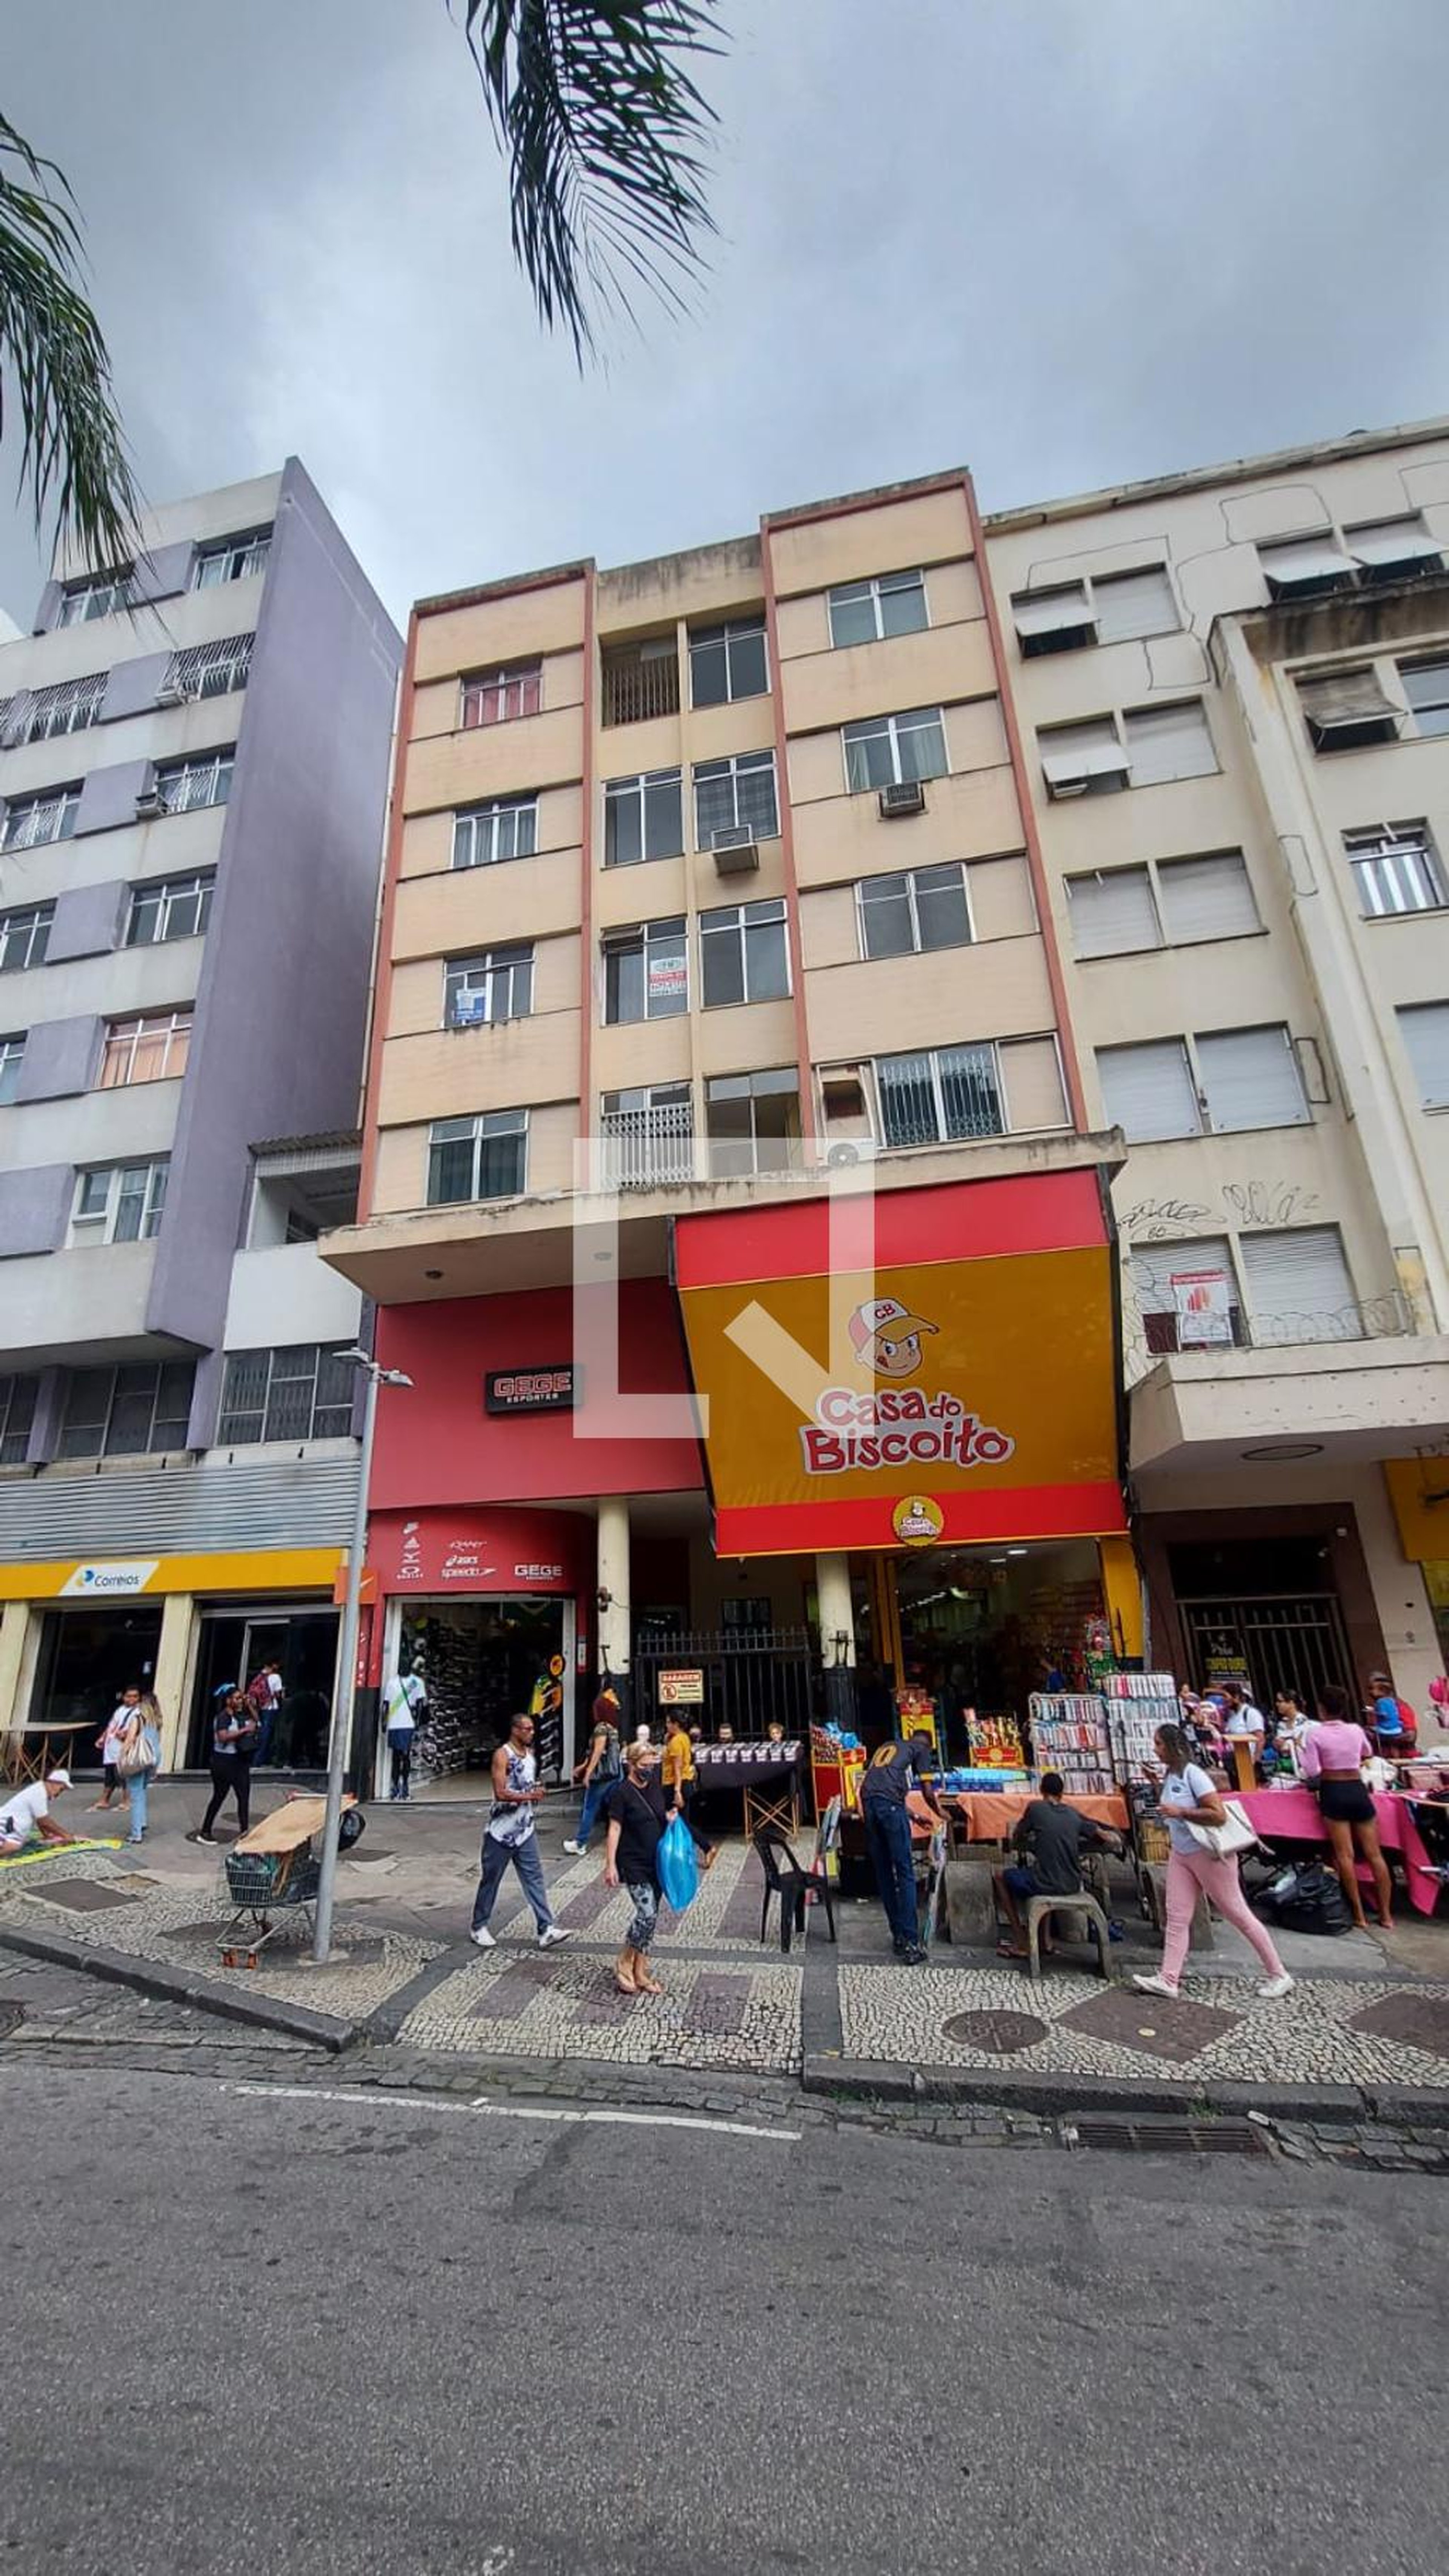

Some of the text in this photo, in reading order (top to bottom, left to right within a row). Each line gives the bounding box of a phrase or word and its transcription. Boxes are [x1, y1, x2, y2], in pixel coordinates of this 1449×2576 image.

[875, 1304, 896, 1319] CB
[494, 1372, 572, 1397] GEGE
[820, 1390, 961, 1426] Casa do
[805, 1418, 1009, 1470] Biscoito
[515, 1564, 563, 1576] GEGE
